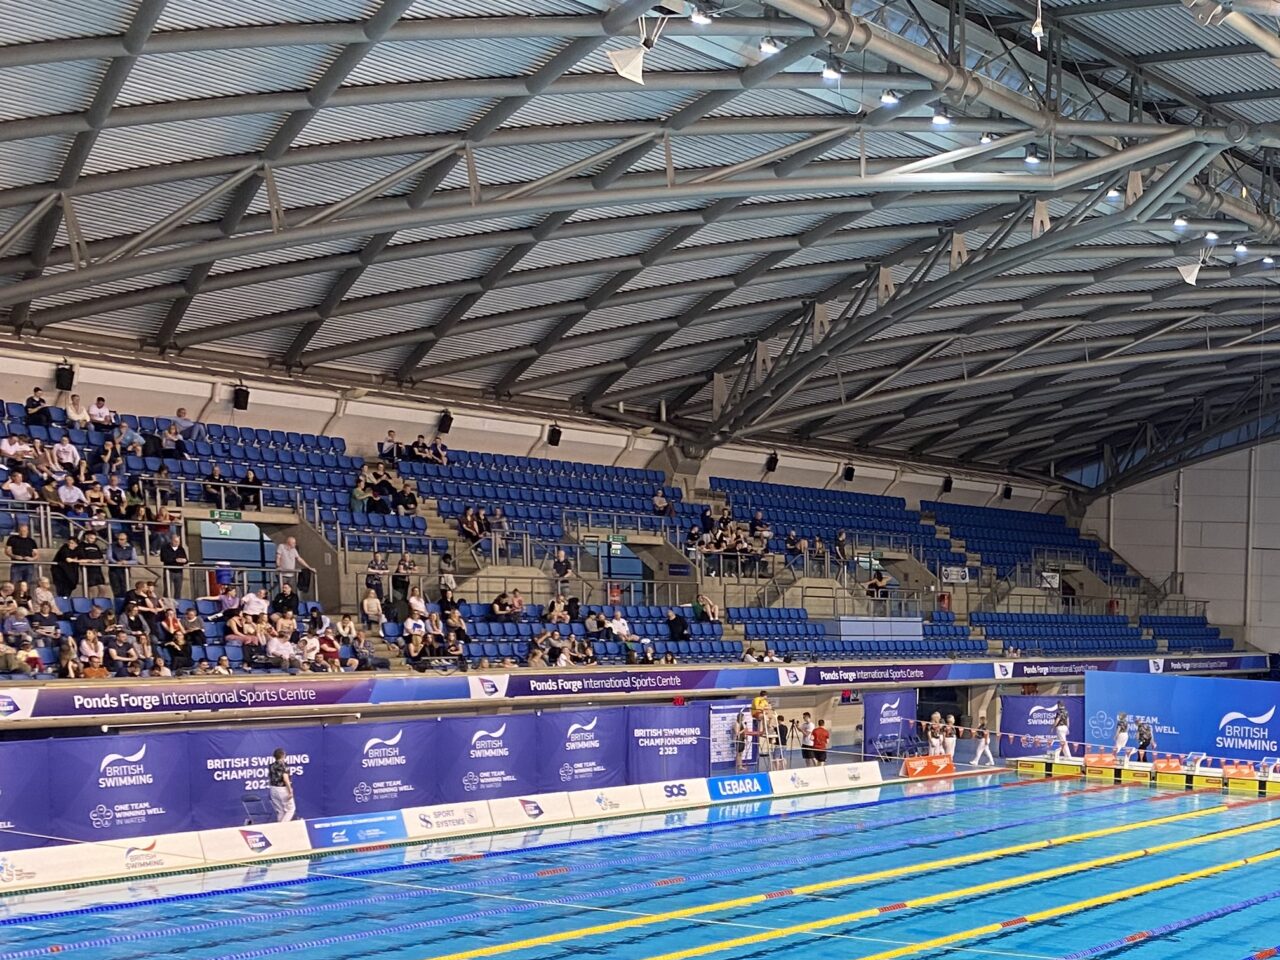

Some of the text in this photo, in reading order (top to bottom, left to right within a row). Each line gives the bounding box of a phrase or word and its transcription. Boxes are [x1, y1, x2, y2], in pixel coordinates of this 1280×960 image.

[820, 669, 924, 682] Ponds Forge International Sports Centre
[530, 675, 681, 692] Ponds Forge International Sports Centre
[73, 687, 316, 710] Ponds Forge International Sports Centre
[570, 732, 594, 741] BRITISH
[634, 727, 700, 737] BRITISH SWIMMING
[1225, 725, 1268, 739] BRITISH
[476, 740, 503, 749] BRITISH
[565, 740, 599, 751] SWIMMING
[639, 737, 698, 747] CHAMPIONSHIPS
[1216, 736, 1278, 752] SWIMMING
[368, 747, 399, 758] BRITISH
[470, 748, 509, 758] SWIMMING
[207, 754, 310, 769] BRITISH SWIMING
[362, 756, 406, 768] SWIMMING
[106, 764, 144, 777] BRITISH
[214, 766, 304, 781] CHAMPIOPS
[99, 773, 153, 788] SWIMMING
[664, 783, 687, 798] SOS
[718, 778, 761, 795] LEBARA
[115, 810, 146, 818] WINNING
[433, 810, 454, 818] SPORT
[124, 816, 147, 824] WATER
[436, 818, 466, 828] SYSTEMS
[130, 853, 157, 862] BRITISH
[125, 859, 164, 870] SWIMMING
